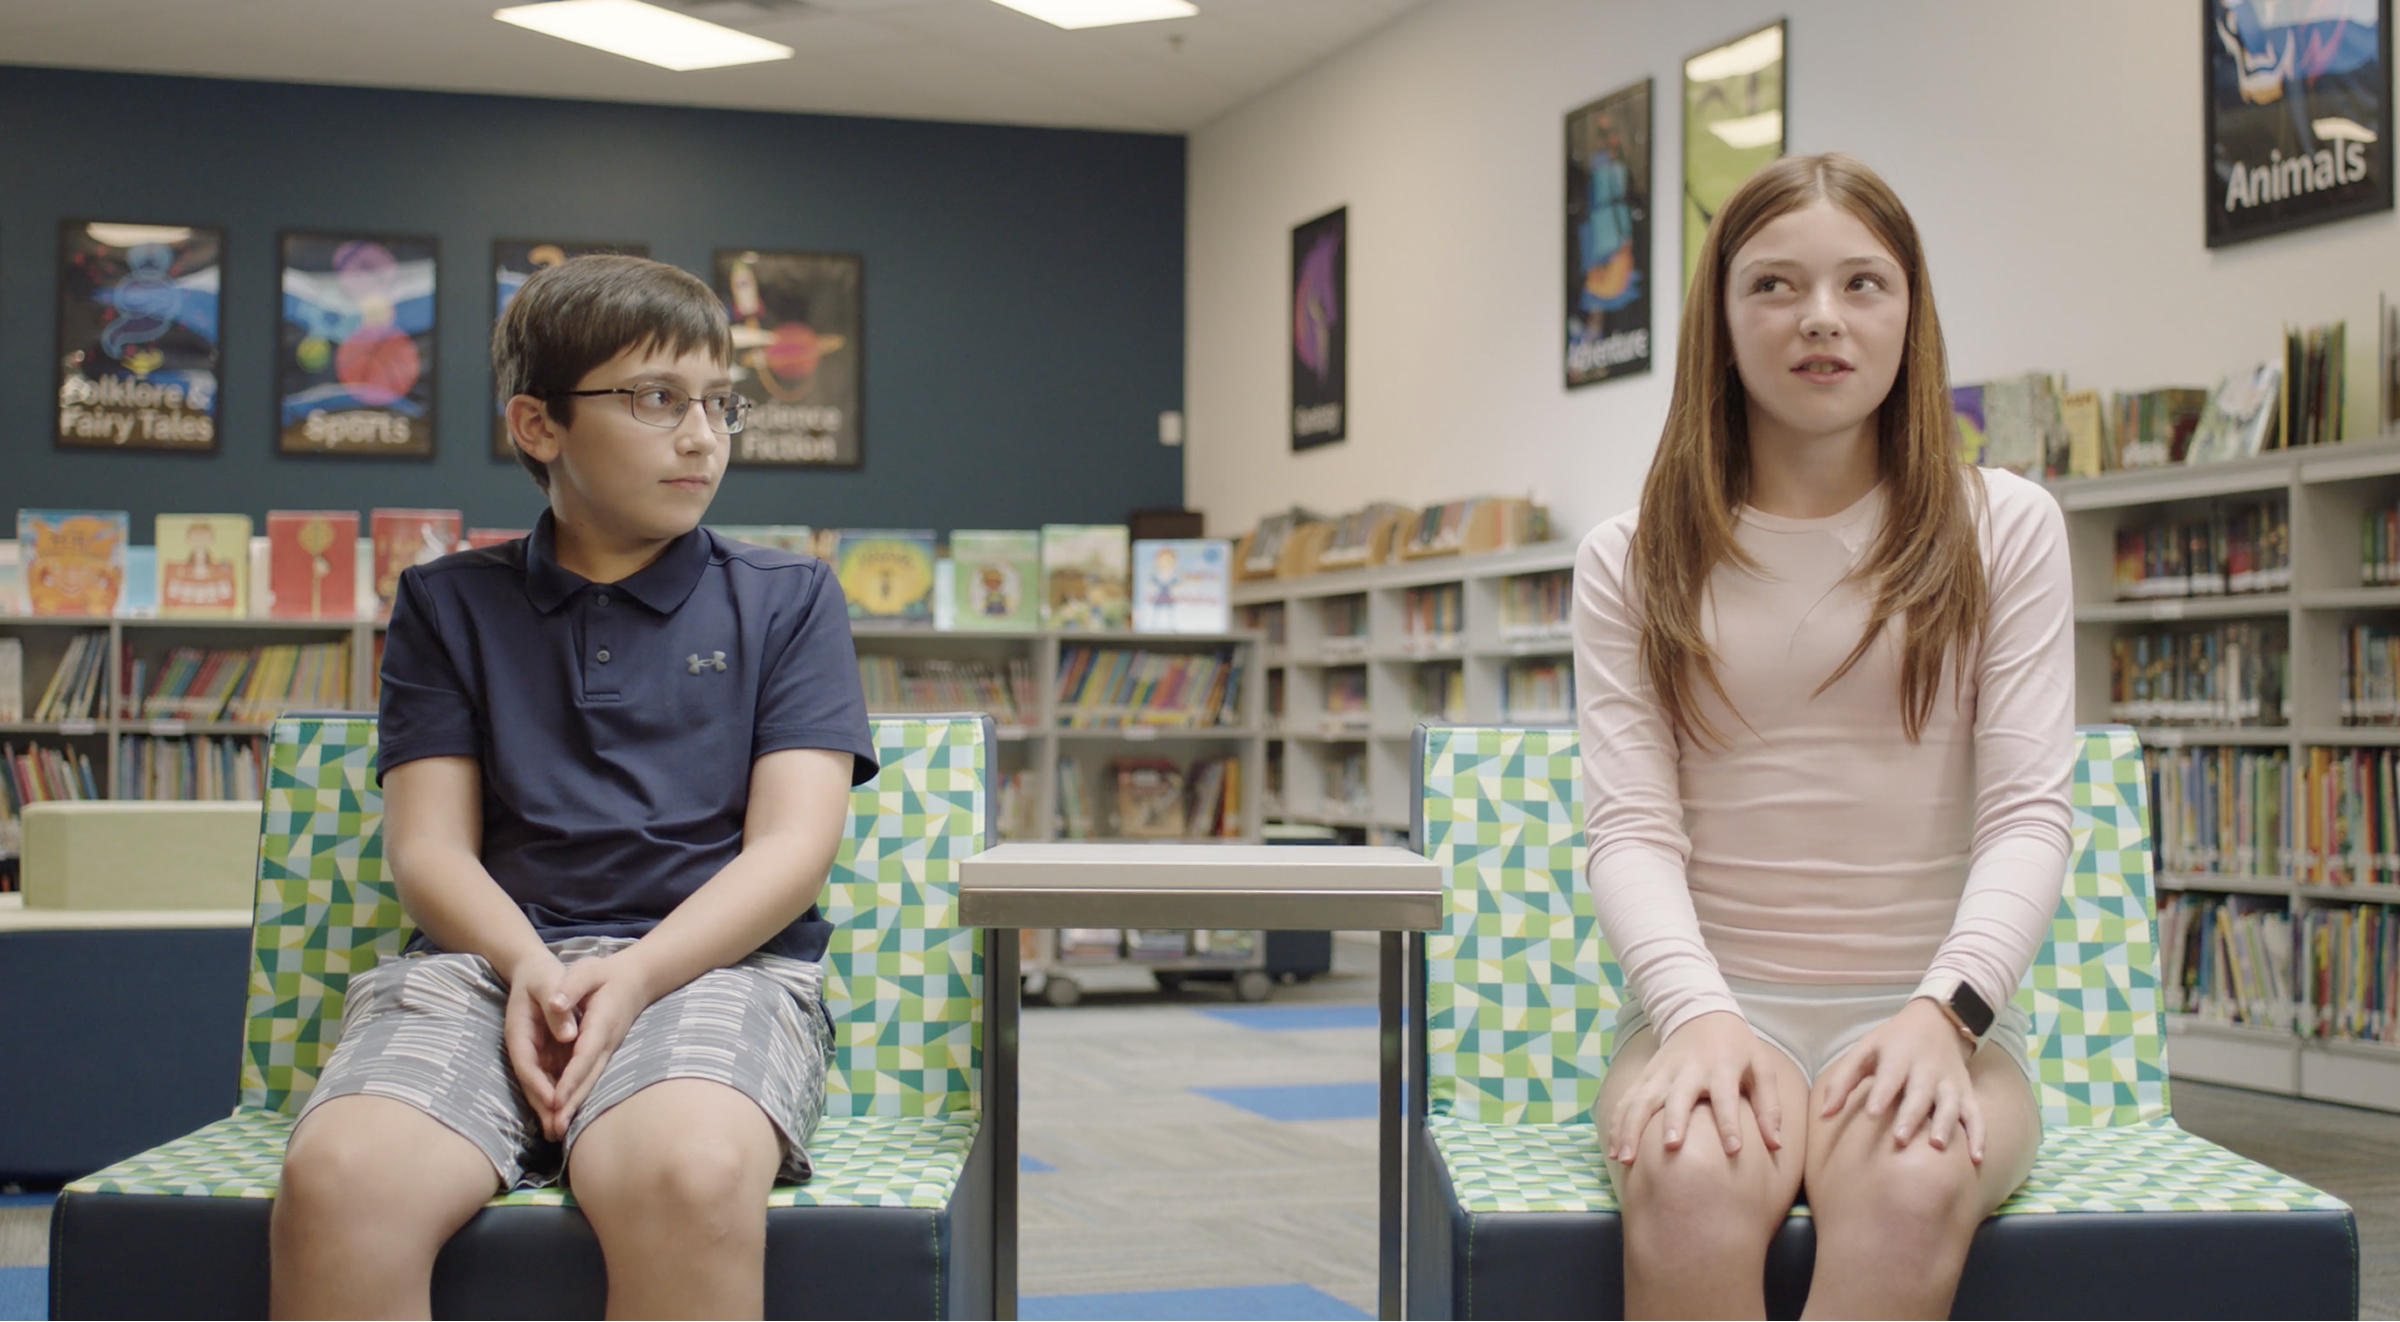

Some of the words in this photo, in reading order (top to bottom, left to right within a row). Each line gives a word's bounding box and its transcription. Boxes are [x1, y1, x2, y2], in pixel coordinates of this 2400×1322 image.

[2225, 138, 2367, 212] Animals
[60, 405, 135, 445] Fairy
[138, 407, 214, 442] Tales
[303, 409, 411, 448] Sports
[741, 429, 837, 461] Fiction
